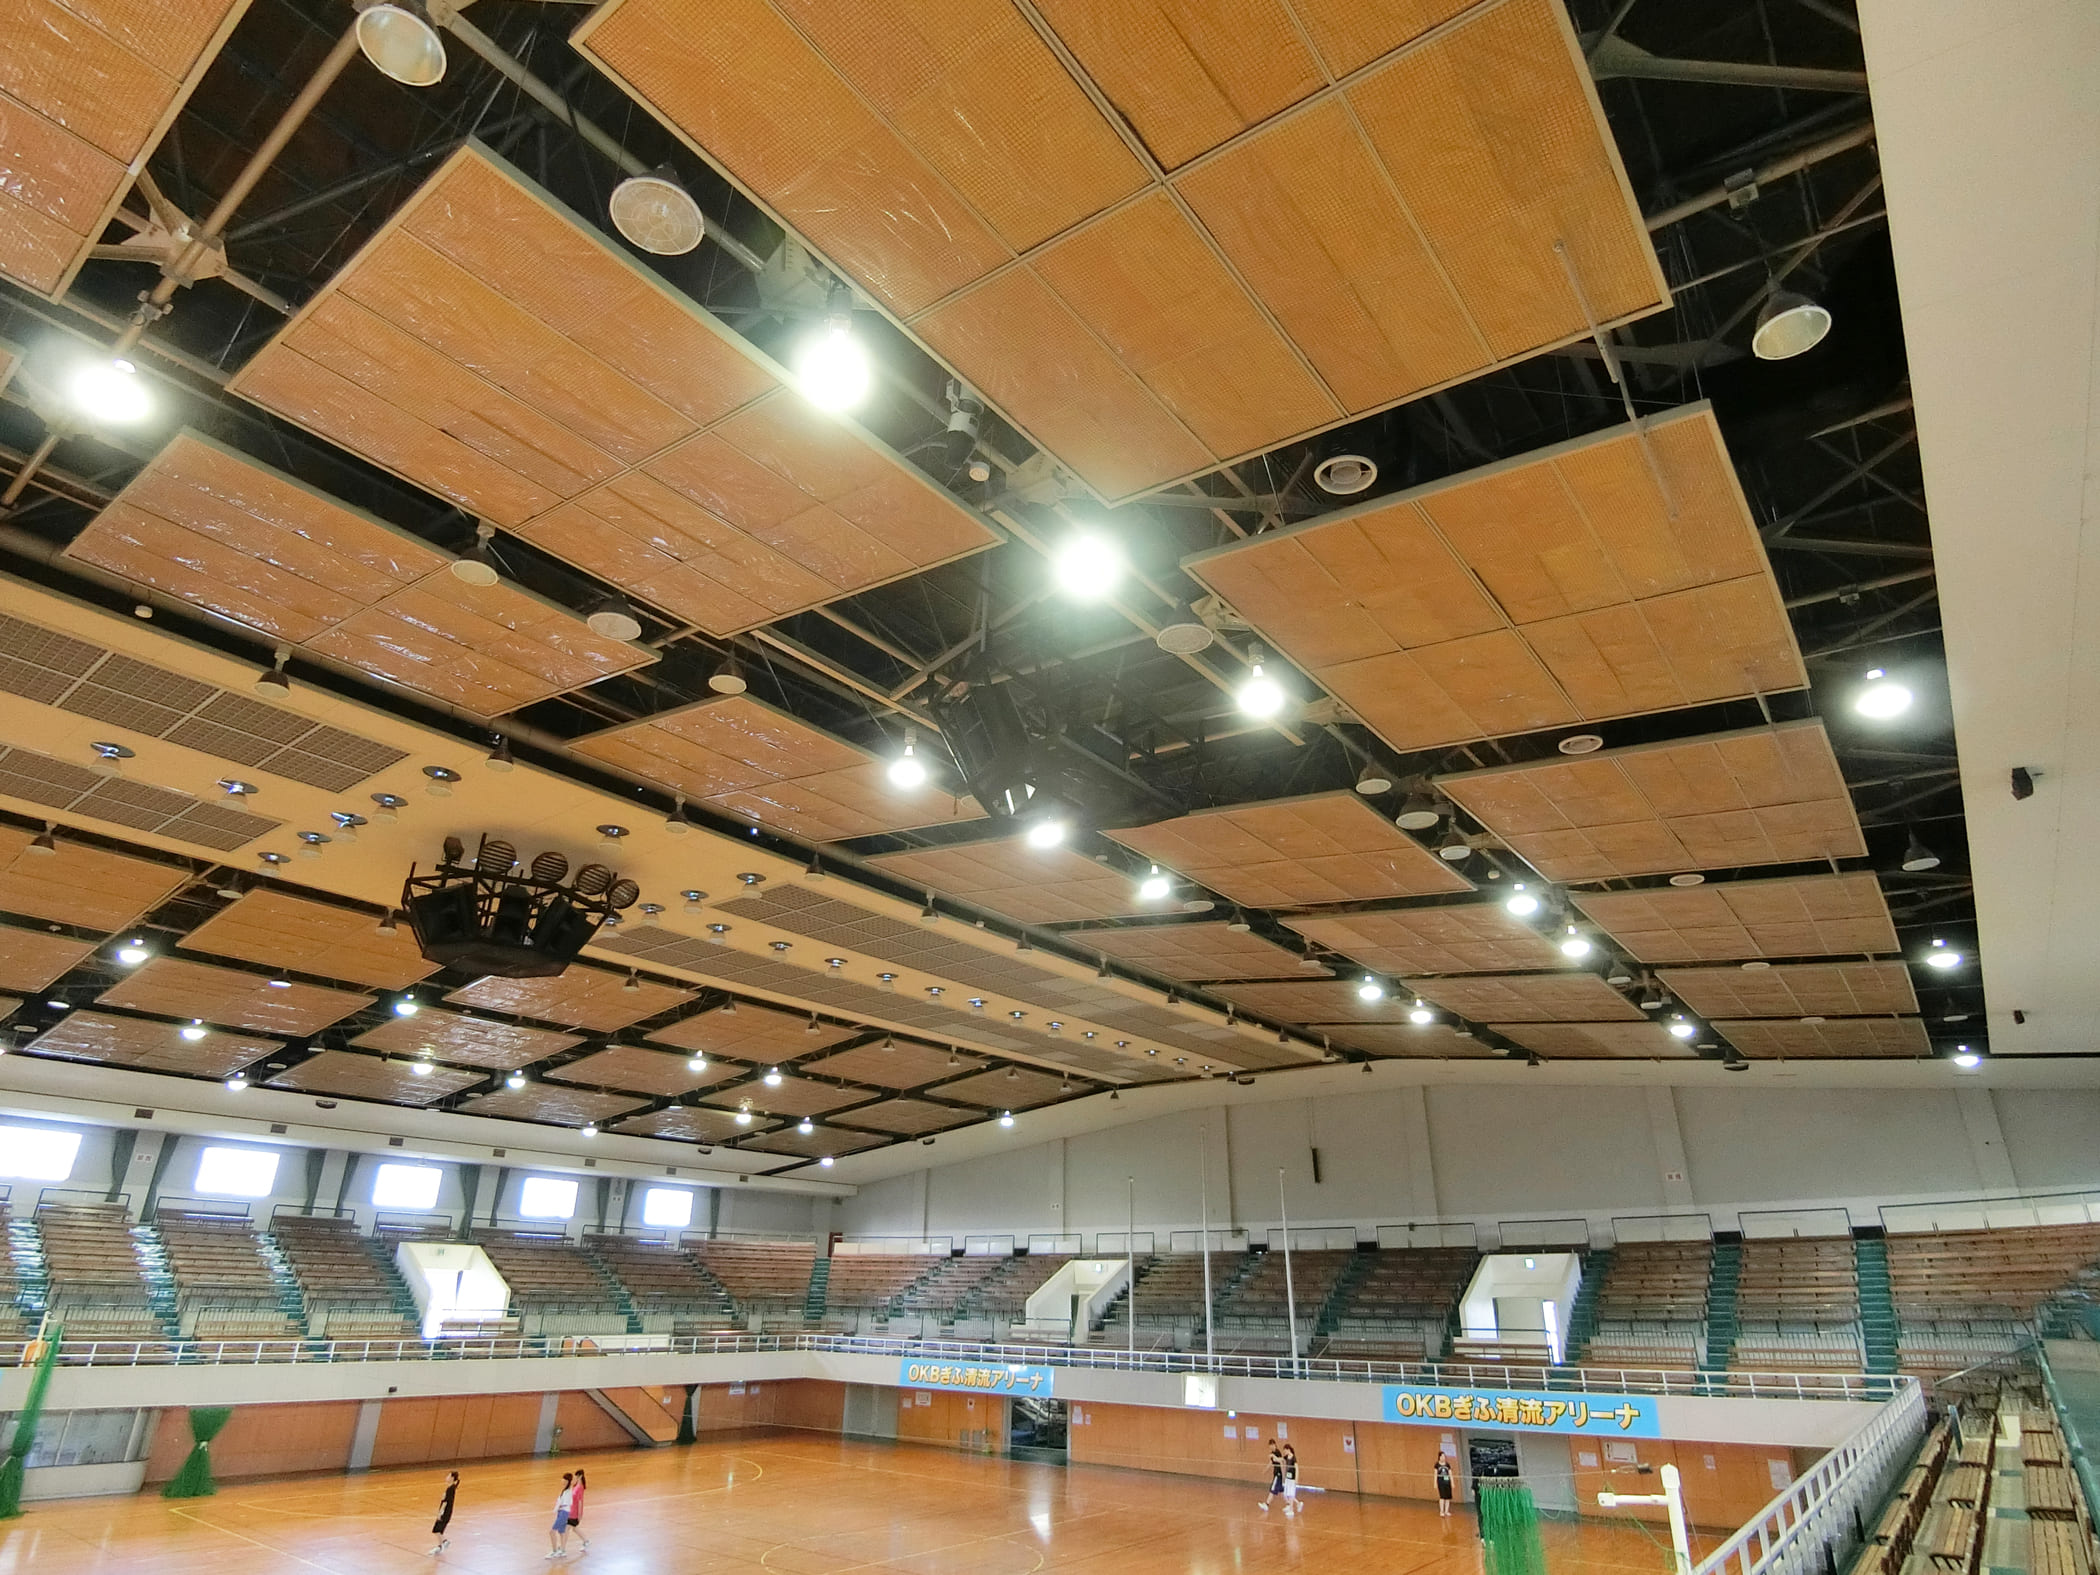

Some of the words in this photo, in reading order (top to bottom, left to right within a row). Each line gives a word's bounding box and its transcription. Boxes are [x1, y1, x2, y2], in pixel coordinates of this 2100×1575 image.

[908, 1364, 1043, 1391] OKBぎふ清流アリーナ
[1396, 1392, 1640, 1429] OKBぎふ清流アリーナ
